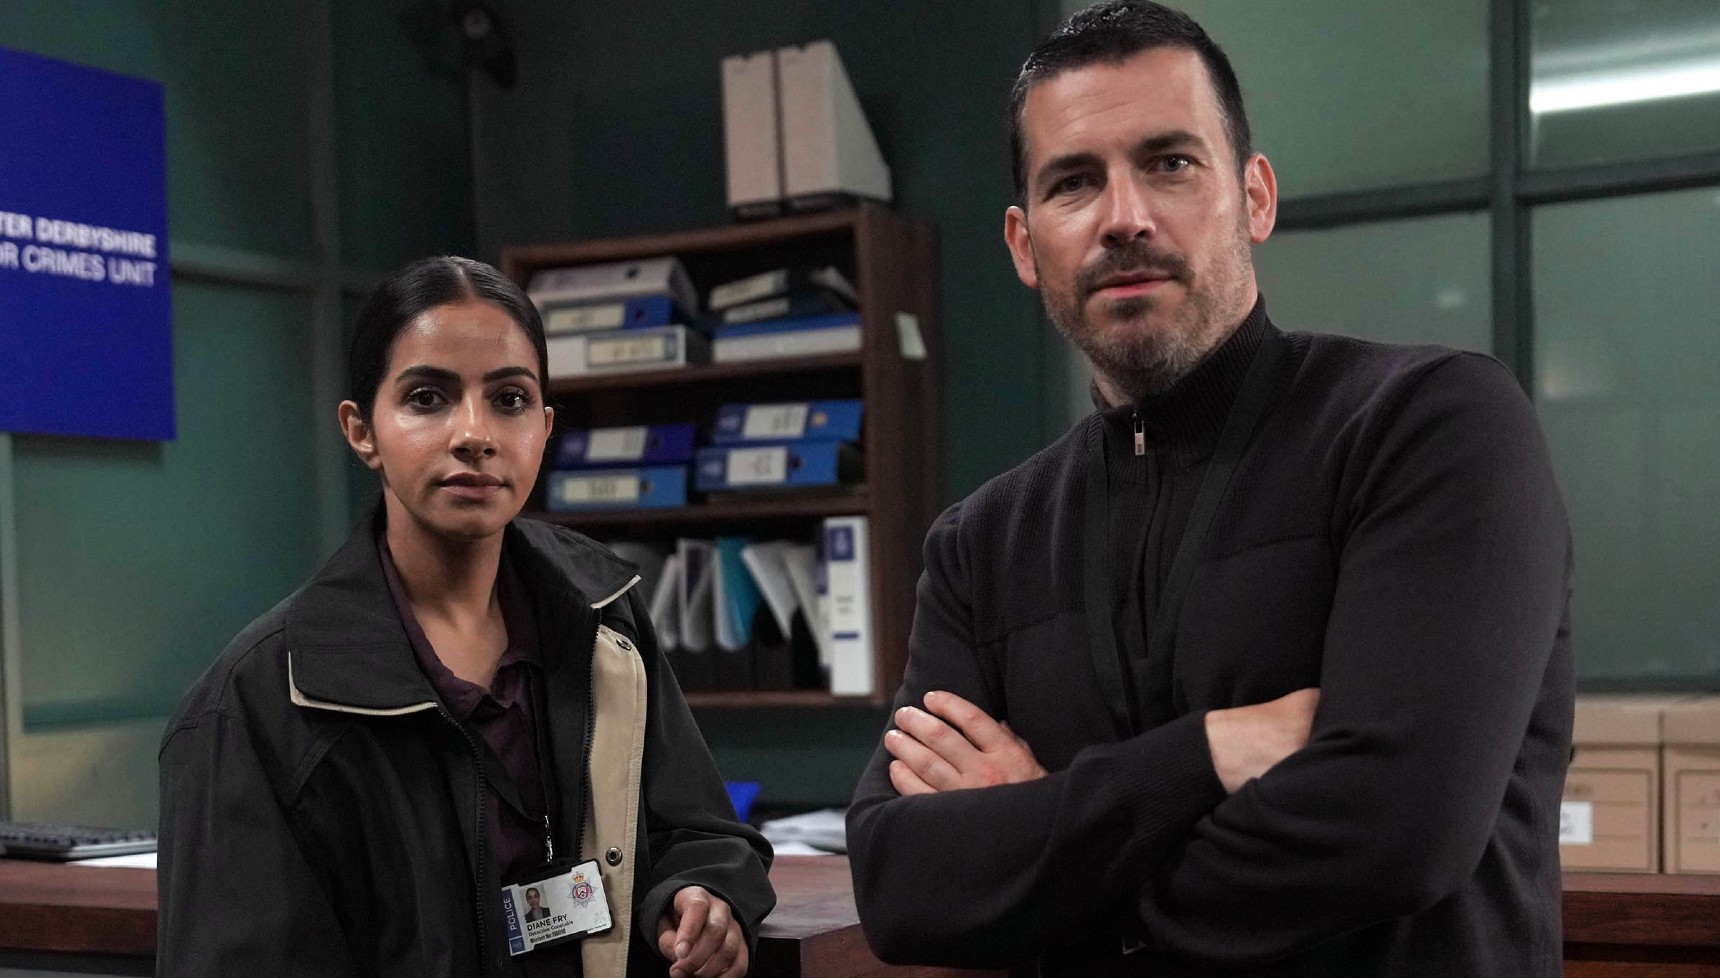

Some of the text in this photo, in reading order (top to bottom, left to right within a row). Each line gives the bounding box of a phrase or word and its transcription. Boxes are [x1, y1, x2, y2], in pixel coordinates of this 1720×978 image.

[35, 217, 157, 258] DERBYSHIRE
[0, 241, 156, 287] R CRIMES UNIT
[503, 897, 517, 931] POLICE
[526, 913, 568, 932] DIANE FRY
[551, 920, 574, 930] Constable
